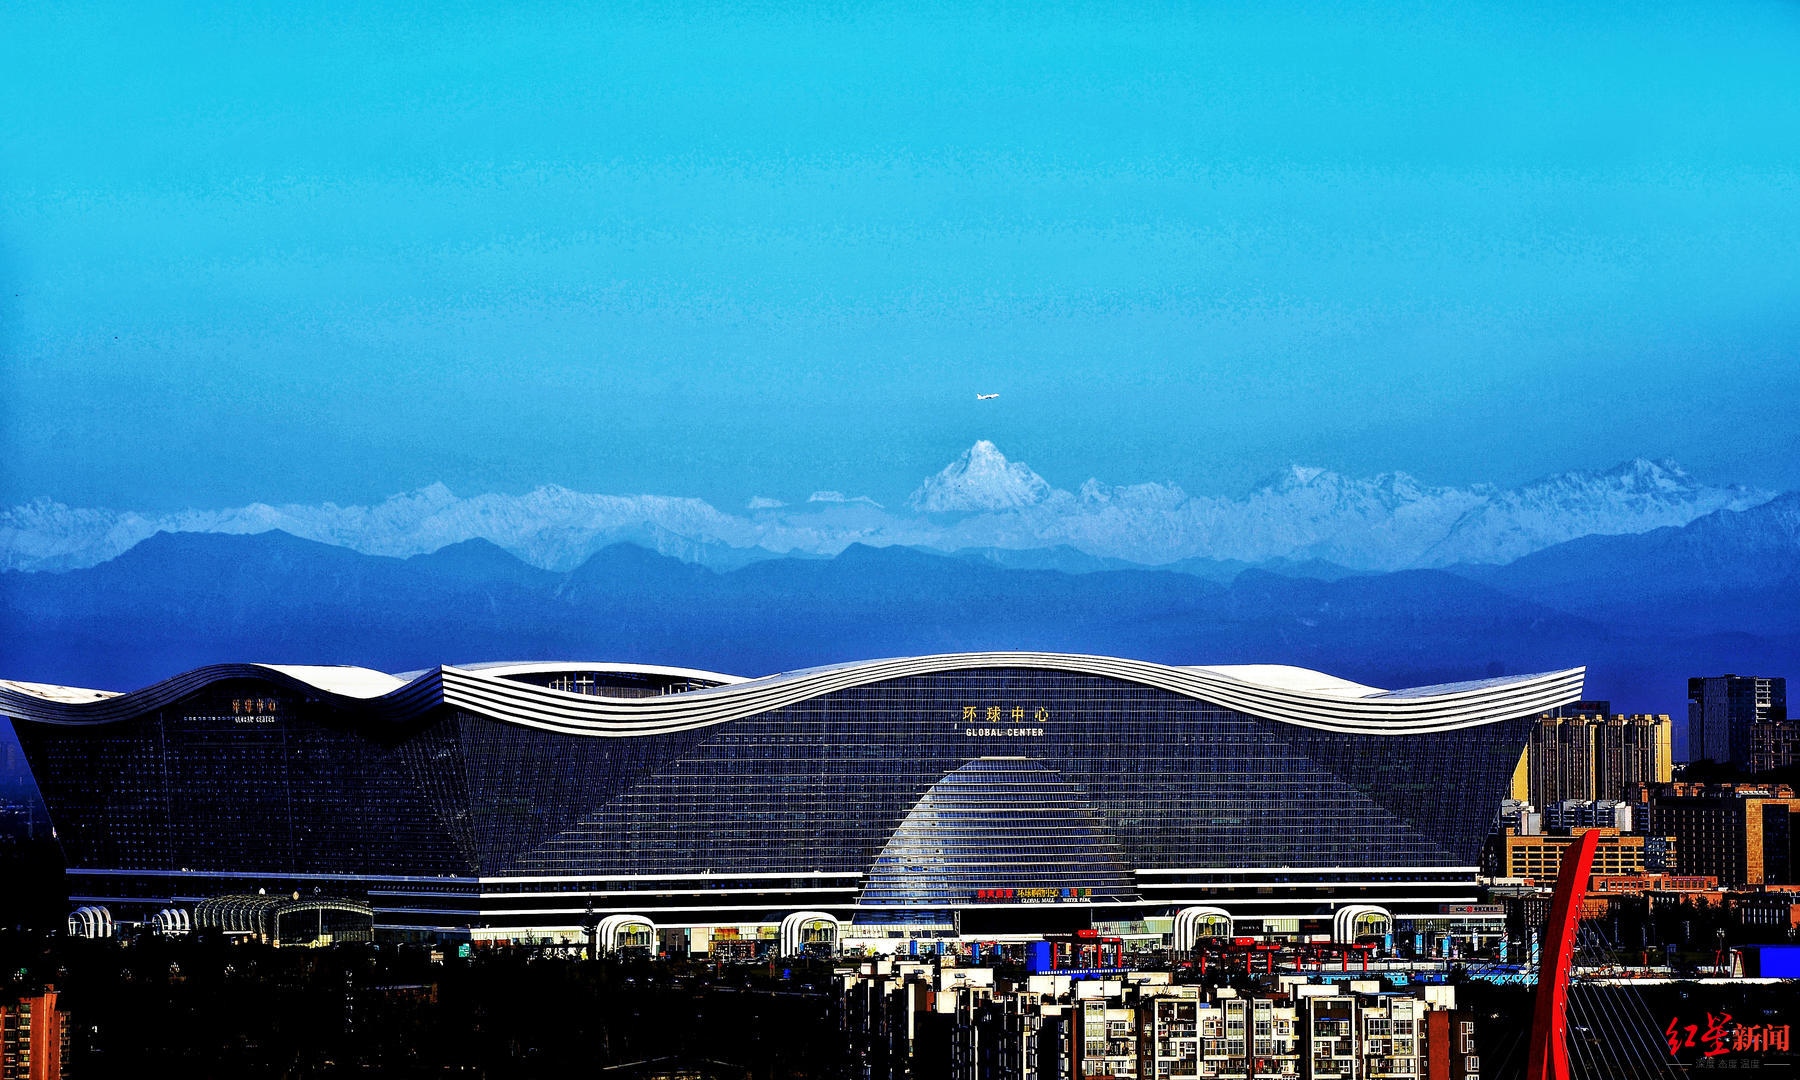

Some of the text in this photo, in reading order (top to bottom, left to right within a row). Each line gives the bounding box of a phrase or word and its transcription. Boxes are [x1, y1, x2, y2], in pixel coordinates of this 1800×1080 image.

[963, 706, 1049, 723] 环球中心
[966, 728, 1044, 737] GLOBAL CENTER
